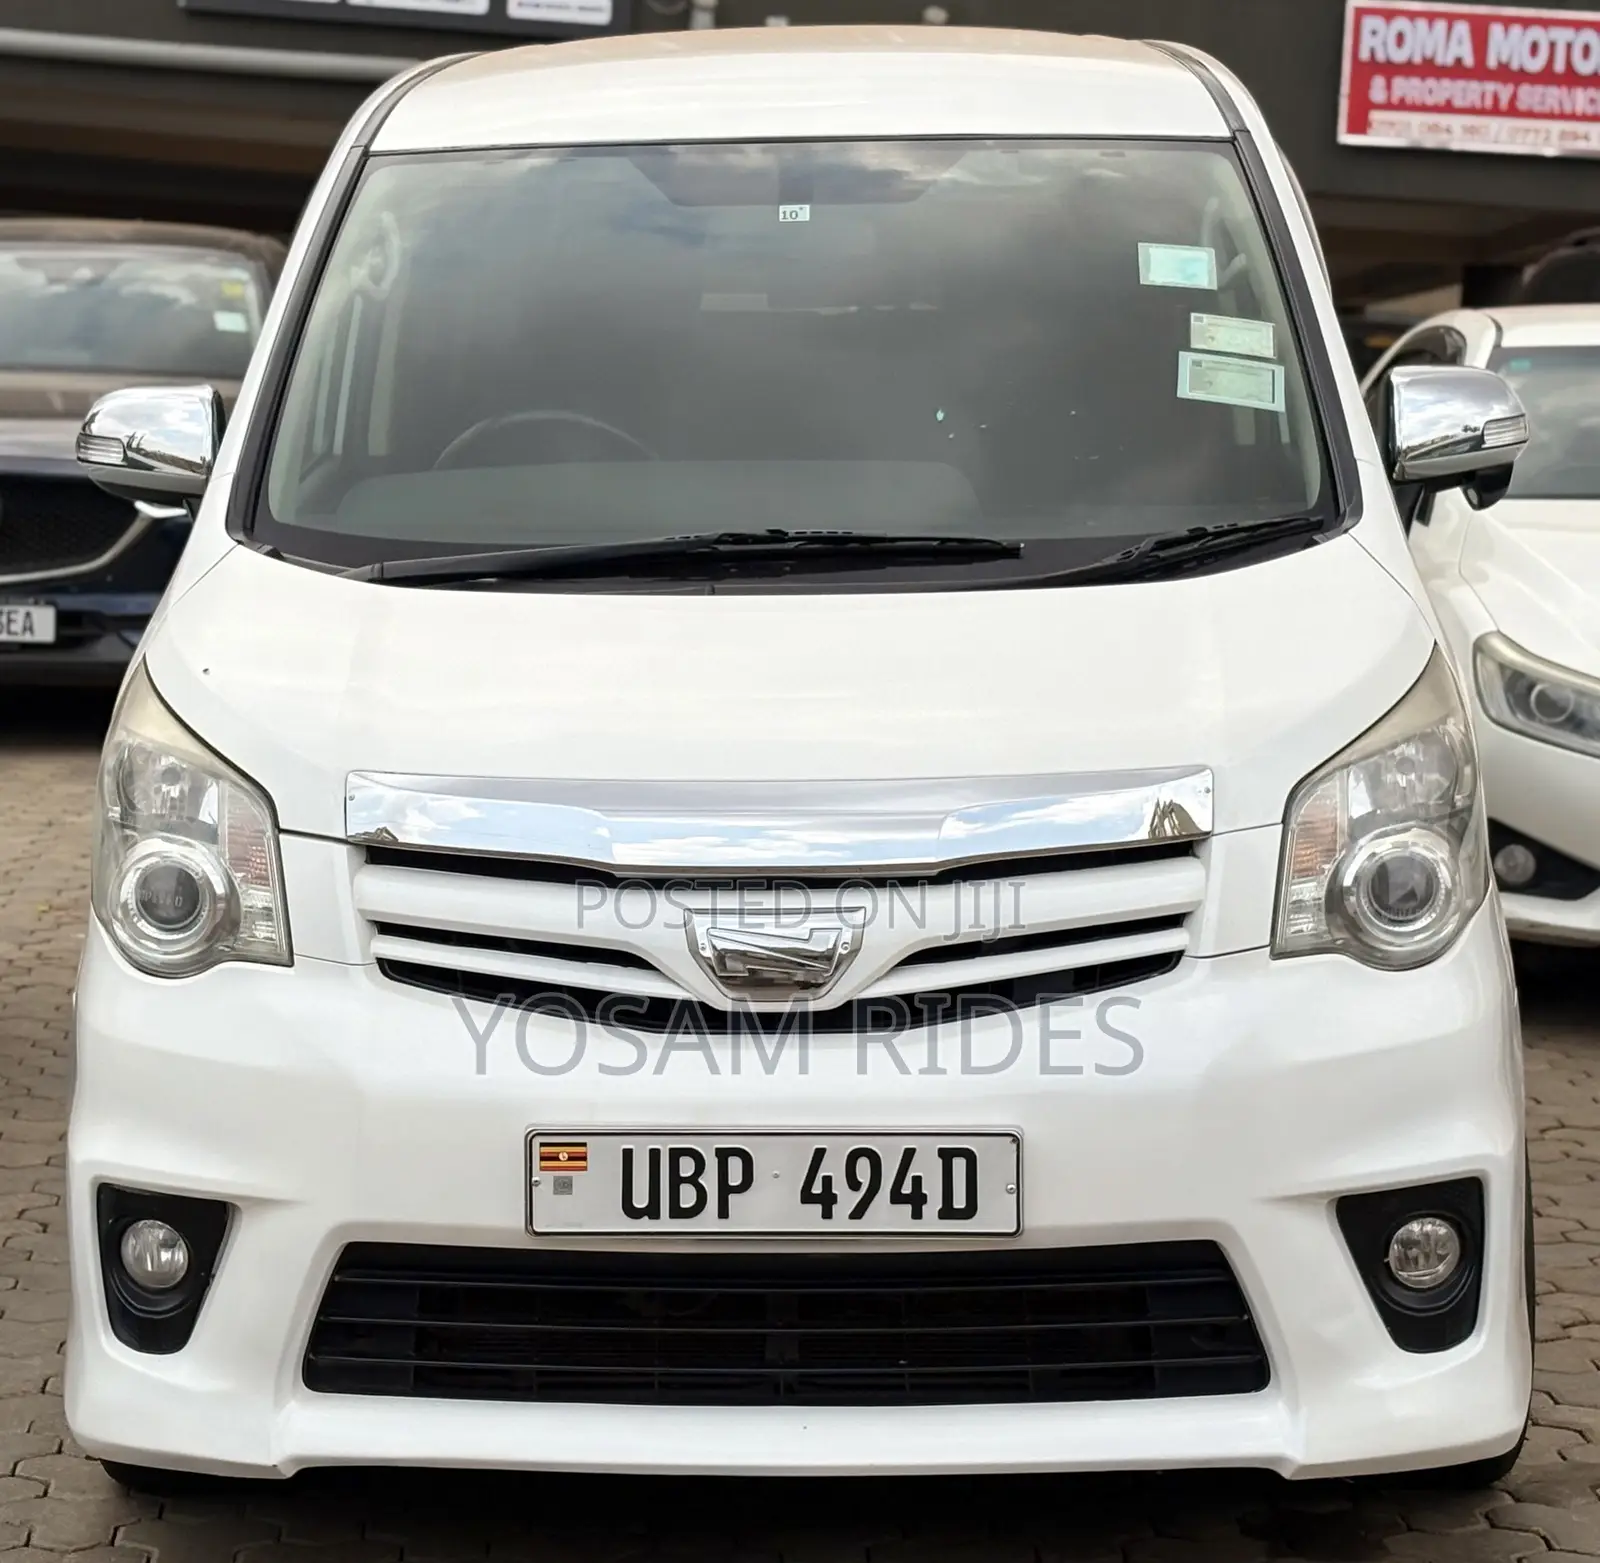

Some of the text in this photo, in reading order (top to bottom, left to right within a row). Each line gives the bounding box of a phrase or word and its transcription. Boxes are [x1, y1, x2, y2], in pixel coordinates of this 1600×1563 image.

[1358, 15, 1600, 76] ROMA MOTO
[1368, 74, 1388, 104] &
[1390, 76, 1515, 111] PROPERTY
[620, 1145, 979, 1221] UBP 494D
